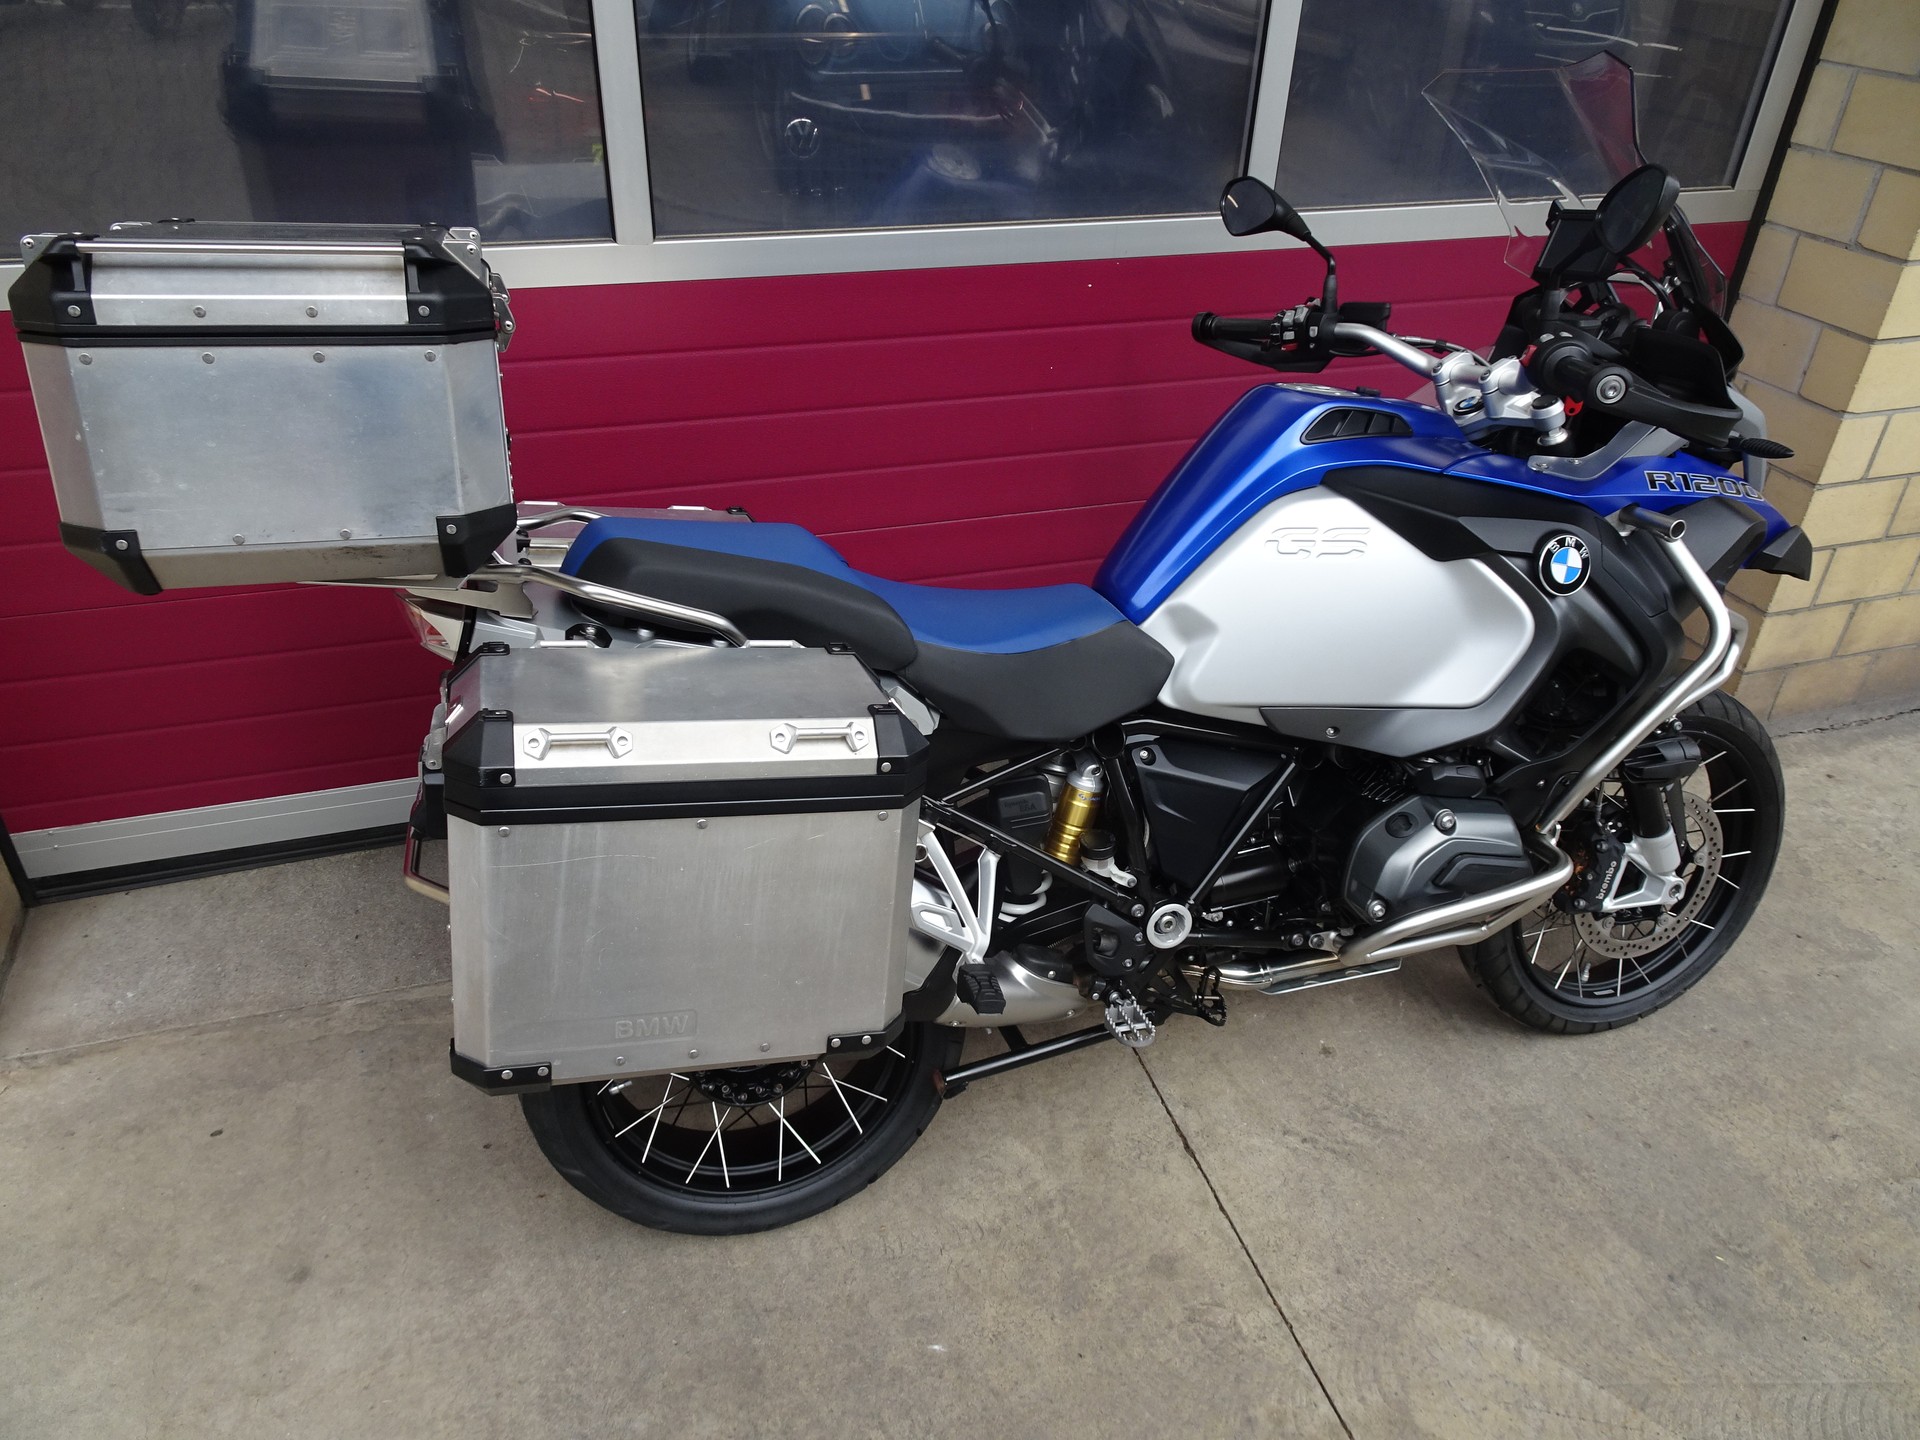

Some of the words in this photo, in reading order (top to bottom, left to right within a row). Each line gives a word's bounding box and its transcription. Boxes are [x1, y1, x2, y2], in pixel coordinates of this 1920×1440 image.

[1644, 470, 1765, 501] R1200
[1264, 527, 1371, 560] GS
[1549, 537, 1590, 559] BMW
[1596, 861, 1617, 900] brembo
[615, 1014, 689, 1039] BMW
